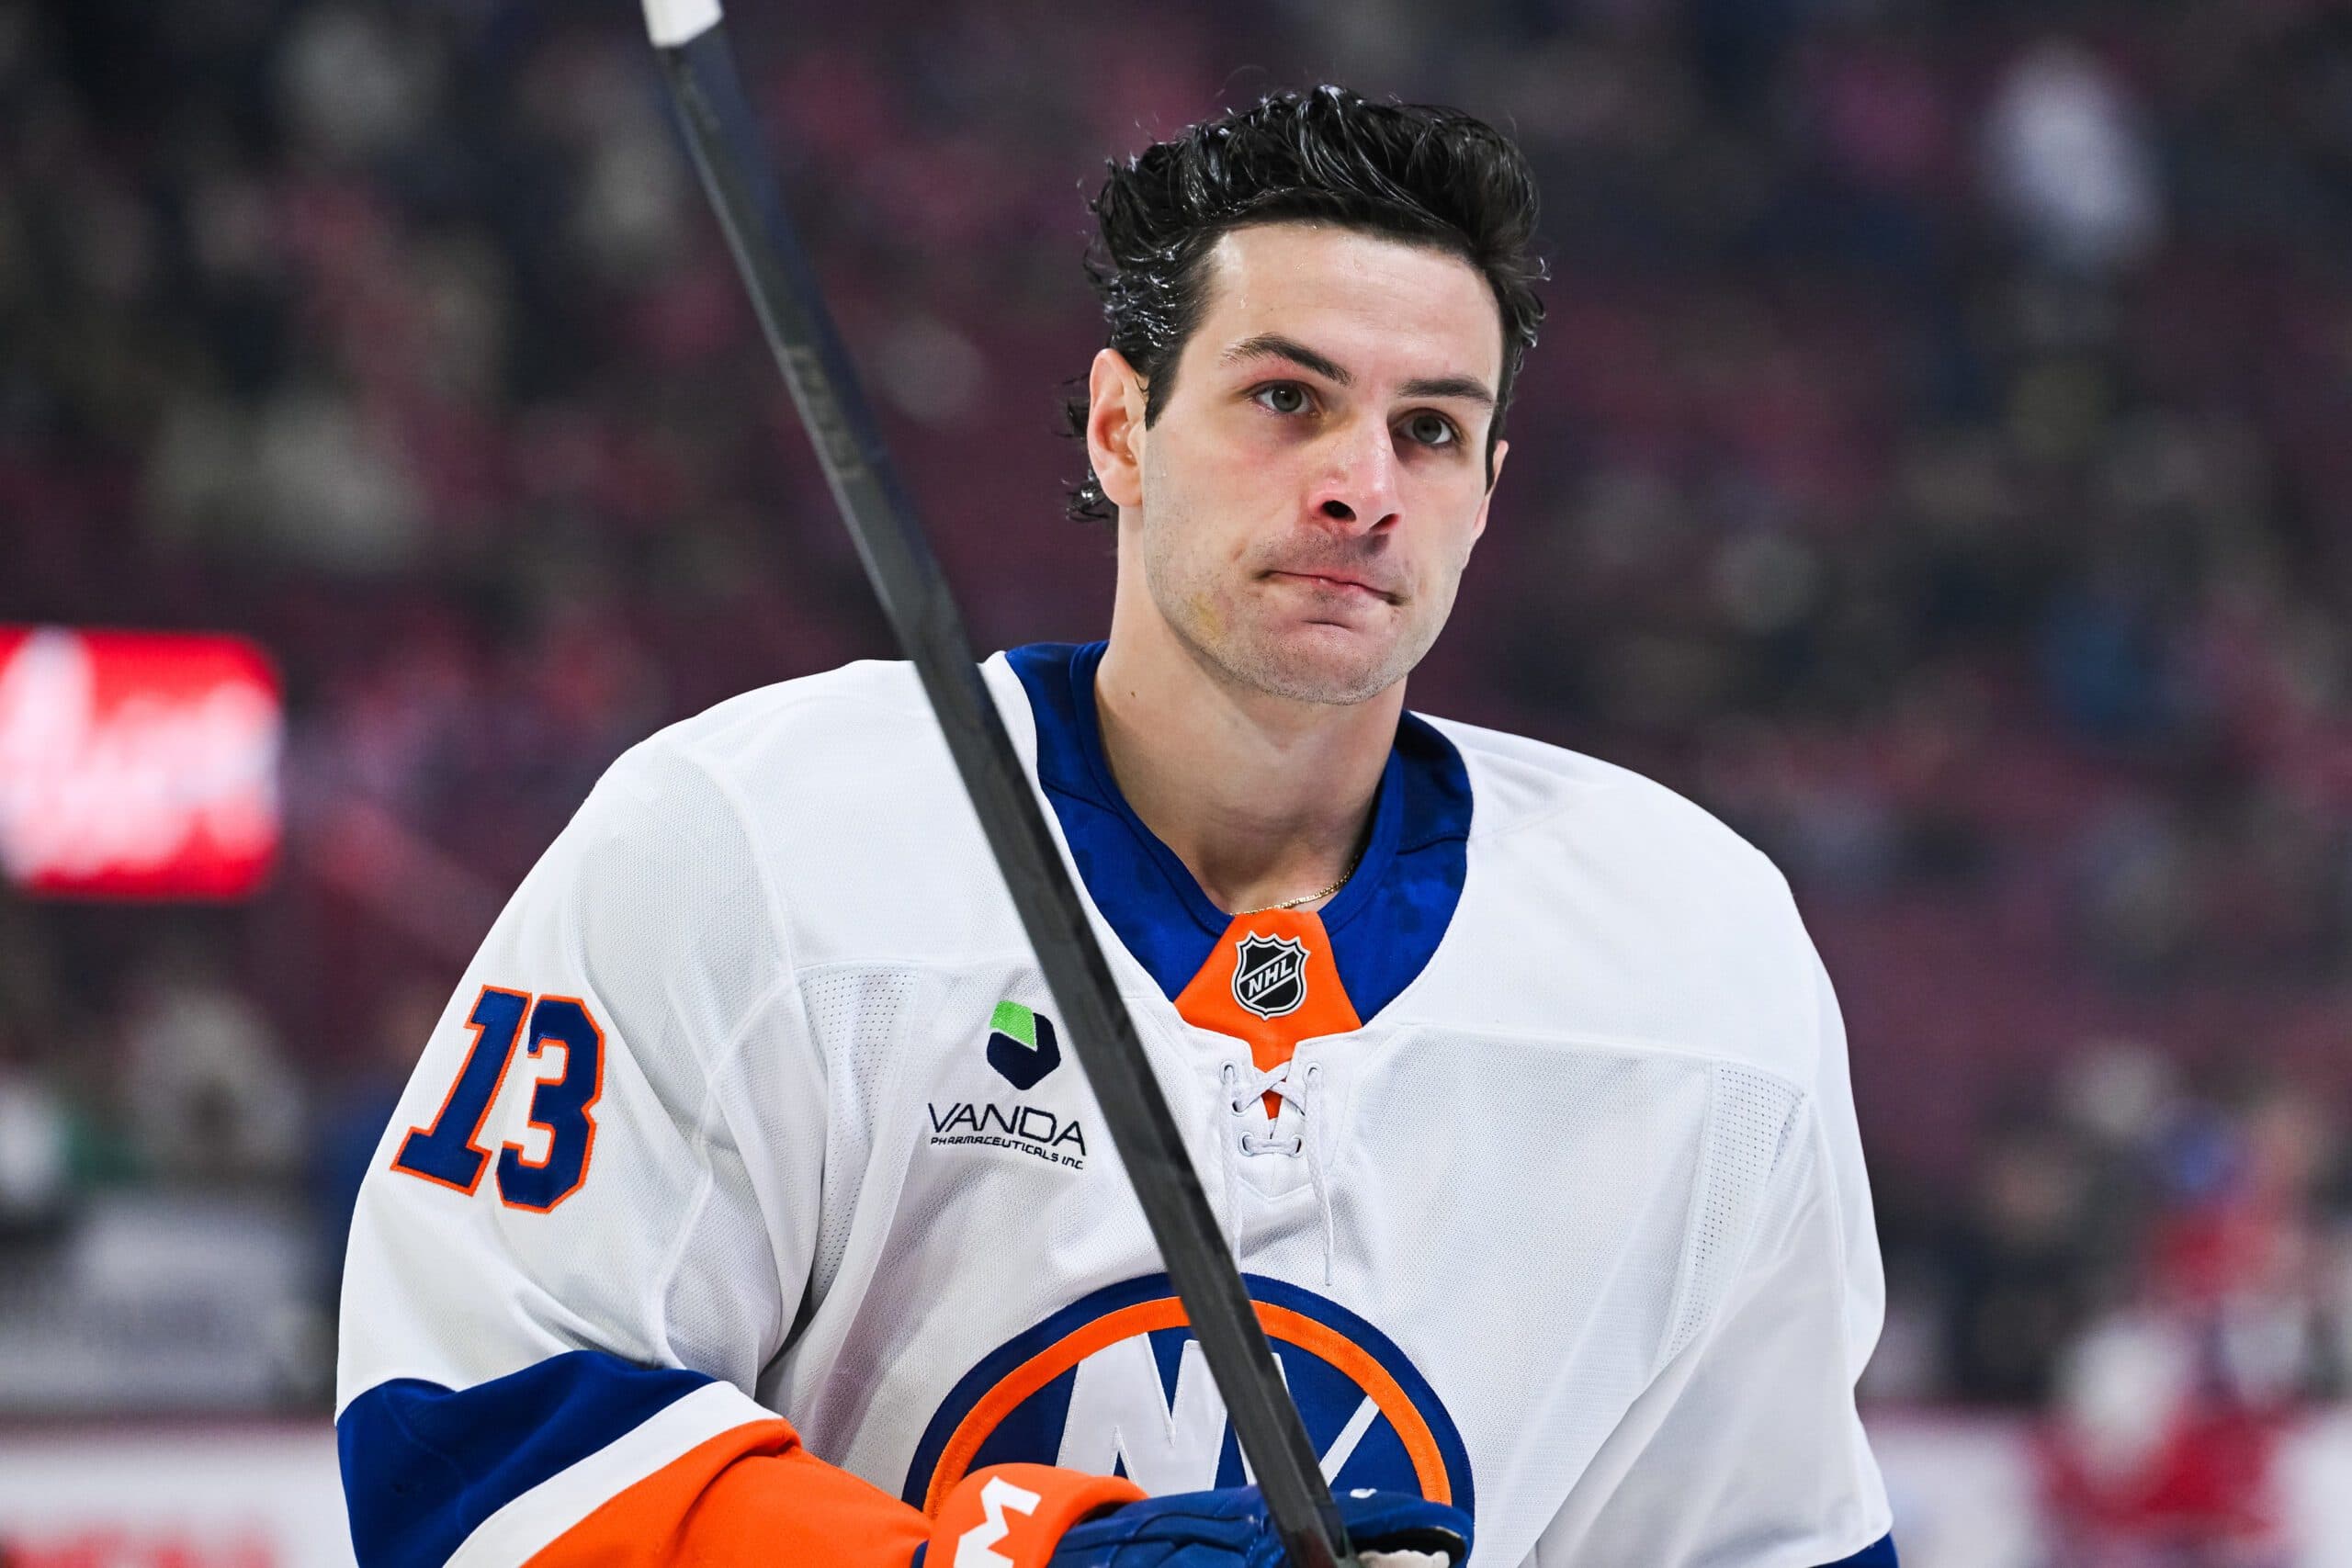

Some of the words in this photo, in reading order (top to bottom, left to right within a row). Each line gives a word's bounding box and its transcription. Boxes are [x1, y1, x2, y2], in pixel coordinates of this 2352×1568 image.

[1248, 958, 1293, 998] NHL
[390, 984, 605, 1214] 13
[928, 1102, 1086, 1156] VANDA
[930, 1135, 1058, 1162] PHARMACEUTICALS
